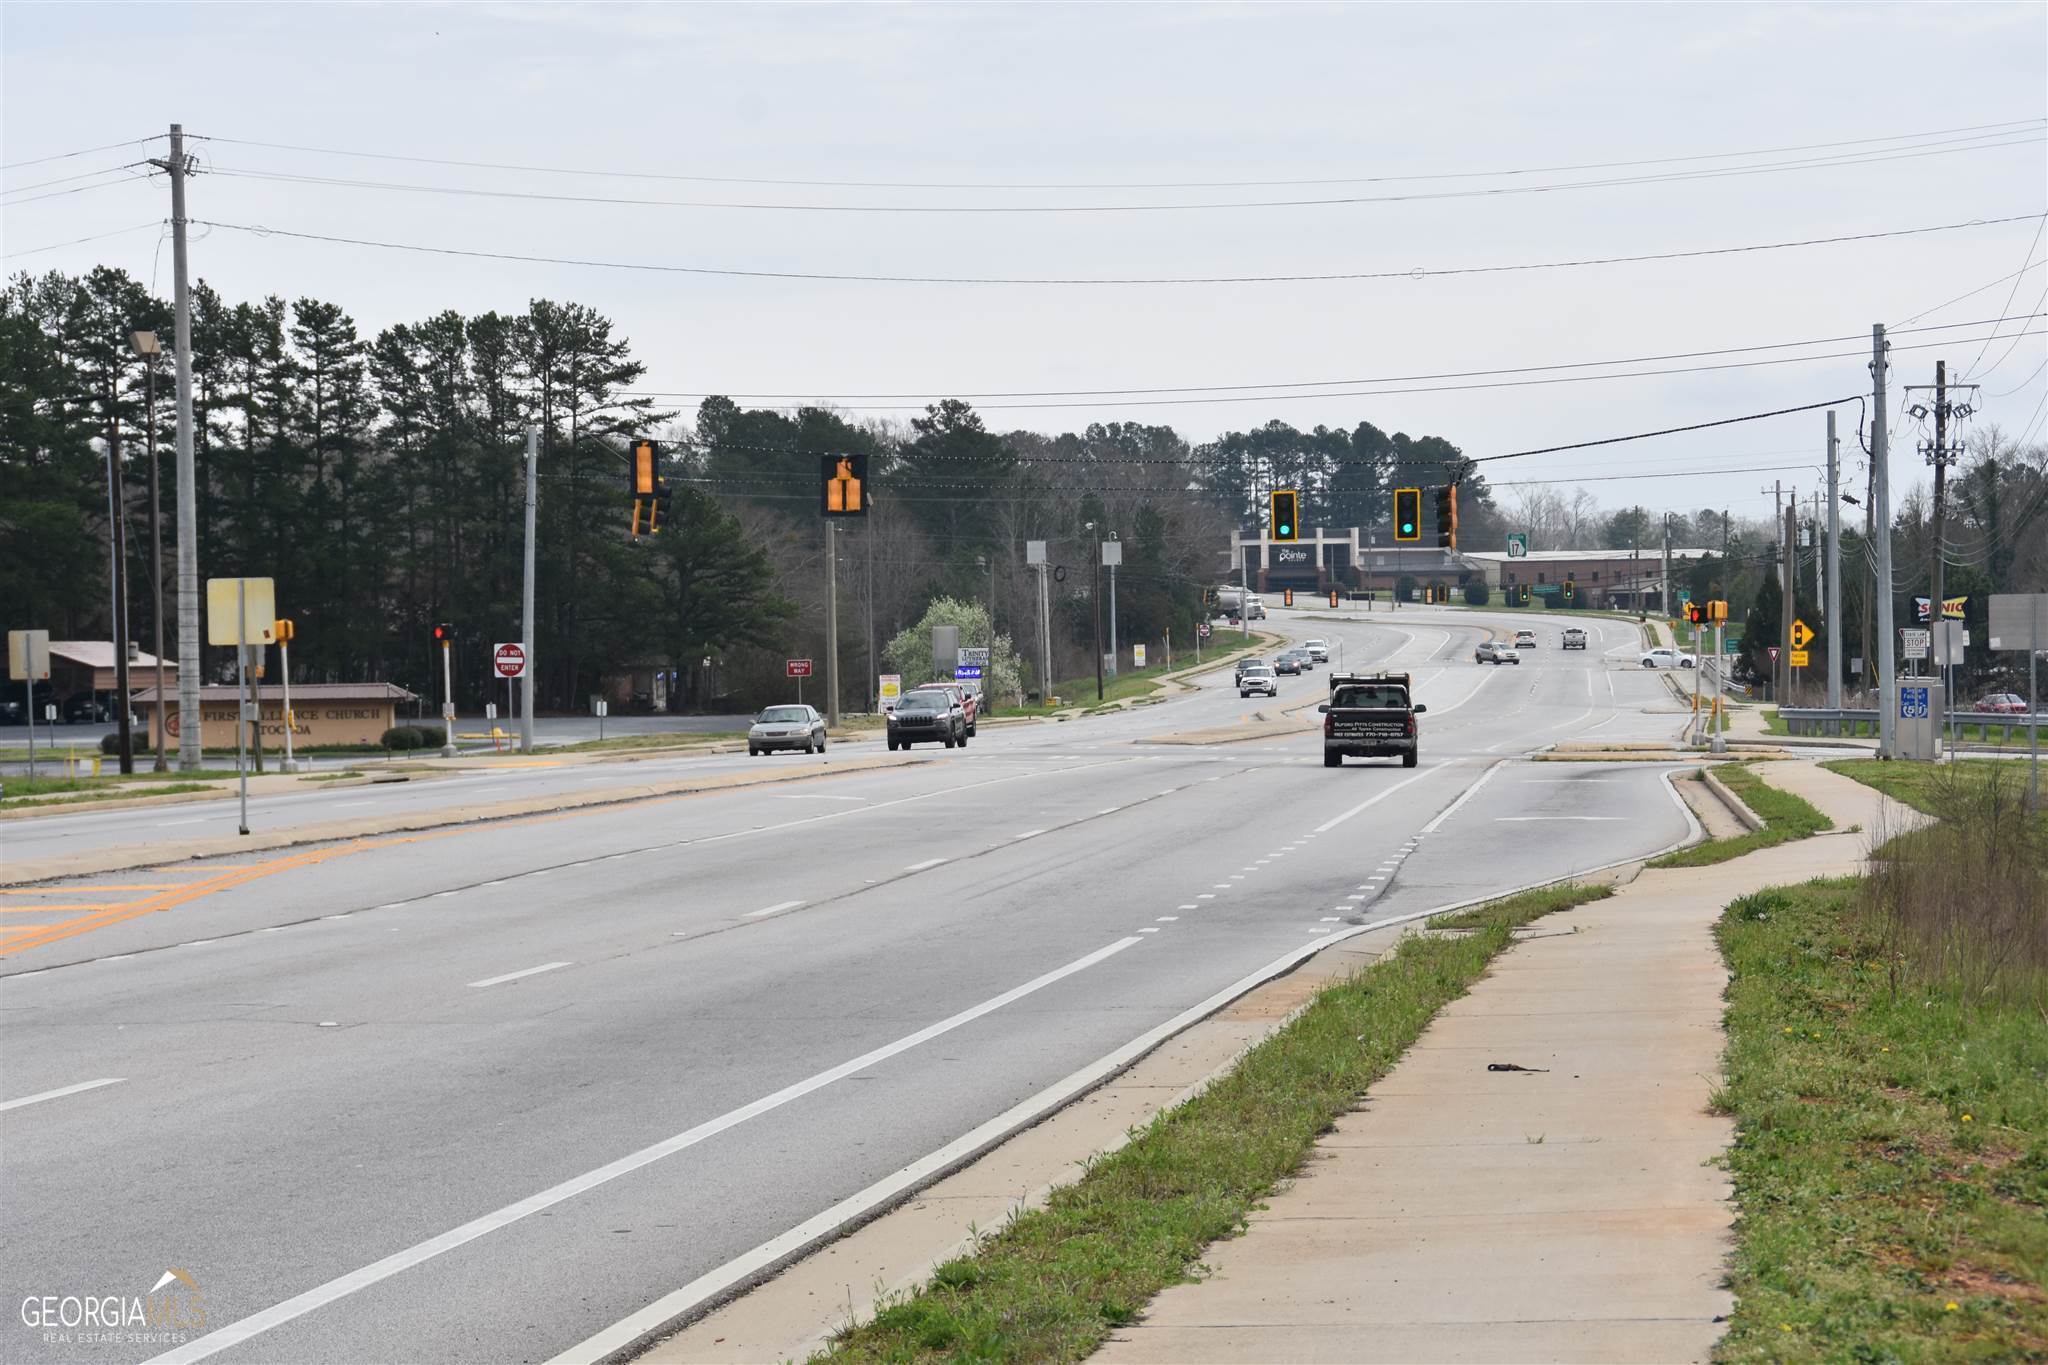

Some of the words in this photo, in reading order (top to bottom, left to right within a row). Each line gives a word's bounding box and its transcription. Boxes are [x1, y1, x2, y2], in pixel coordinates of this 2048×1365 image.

[1511, 543, 1519, 555] 17
[1280, 550, 1307, 562] pointe
[1919, 602, 1964, 613] SNIC
[1906, 639, 1924, 647] STOP
[961, 649, 989, 657] TRINITY
[256, 710, 319, 721] LLINCE
[326, 709, 380, 720] CHURCH
[260, 725, 312, 735] TOCOA
